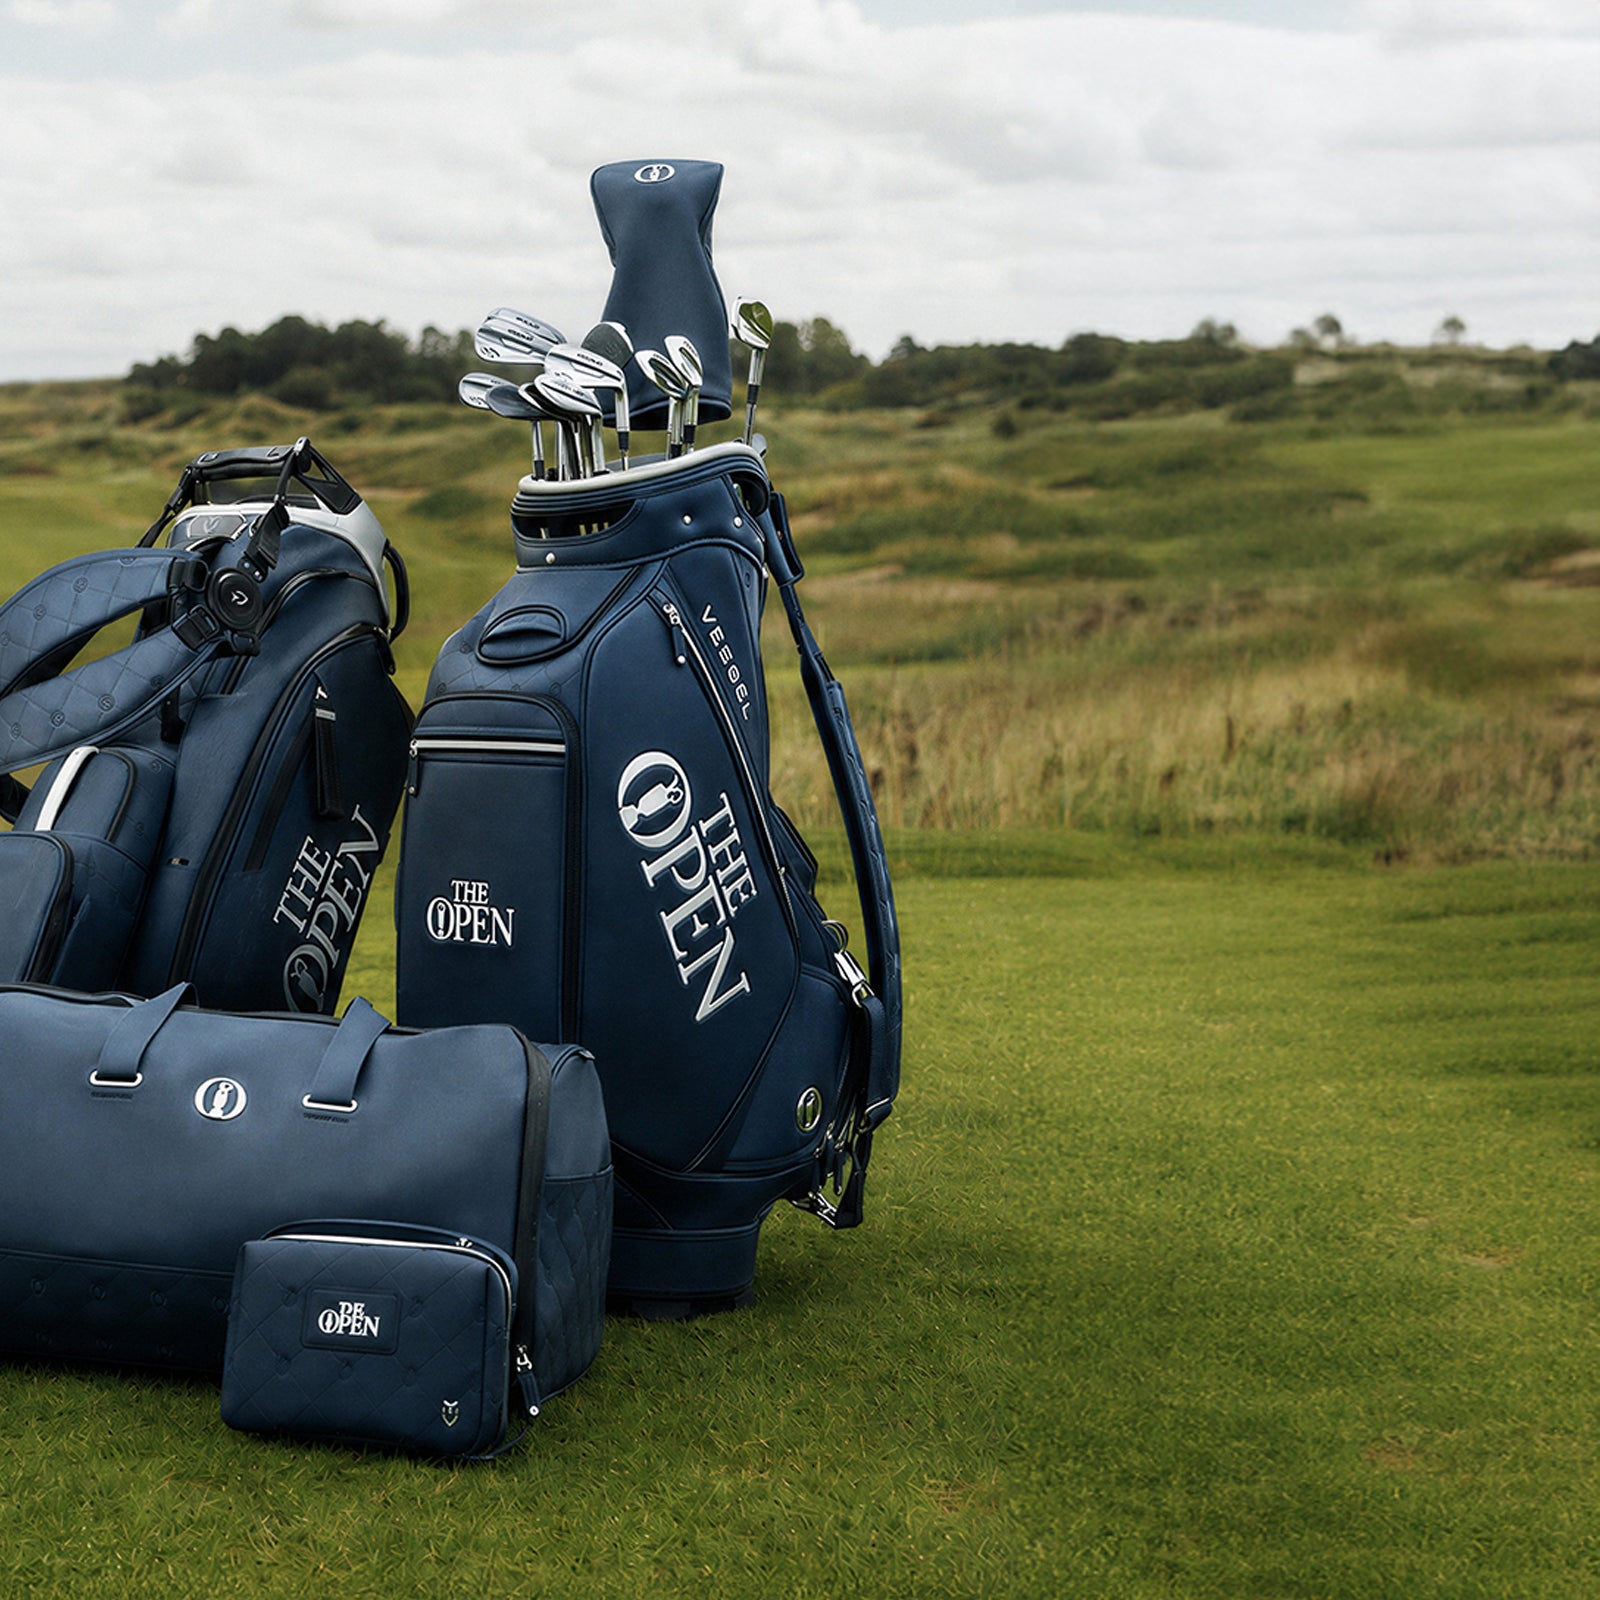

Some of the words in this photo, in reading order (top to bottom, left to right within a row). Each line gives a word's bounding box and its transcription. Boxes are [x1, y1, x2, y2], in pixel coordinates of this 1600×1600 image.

[273, 835, 331, 934] THE
[450, 880, 489, 904] THE
[617, 751, 752, 1022] OPEN
[699, 792, 758, 917] THE
[283, 804, 380, 1012] OPEN
[426, 896, 515, 946] OPEN
[318, 1309, 380, 1337] OPEN
